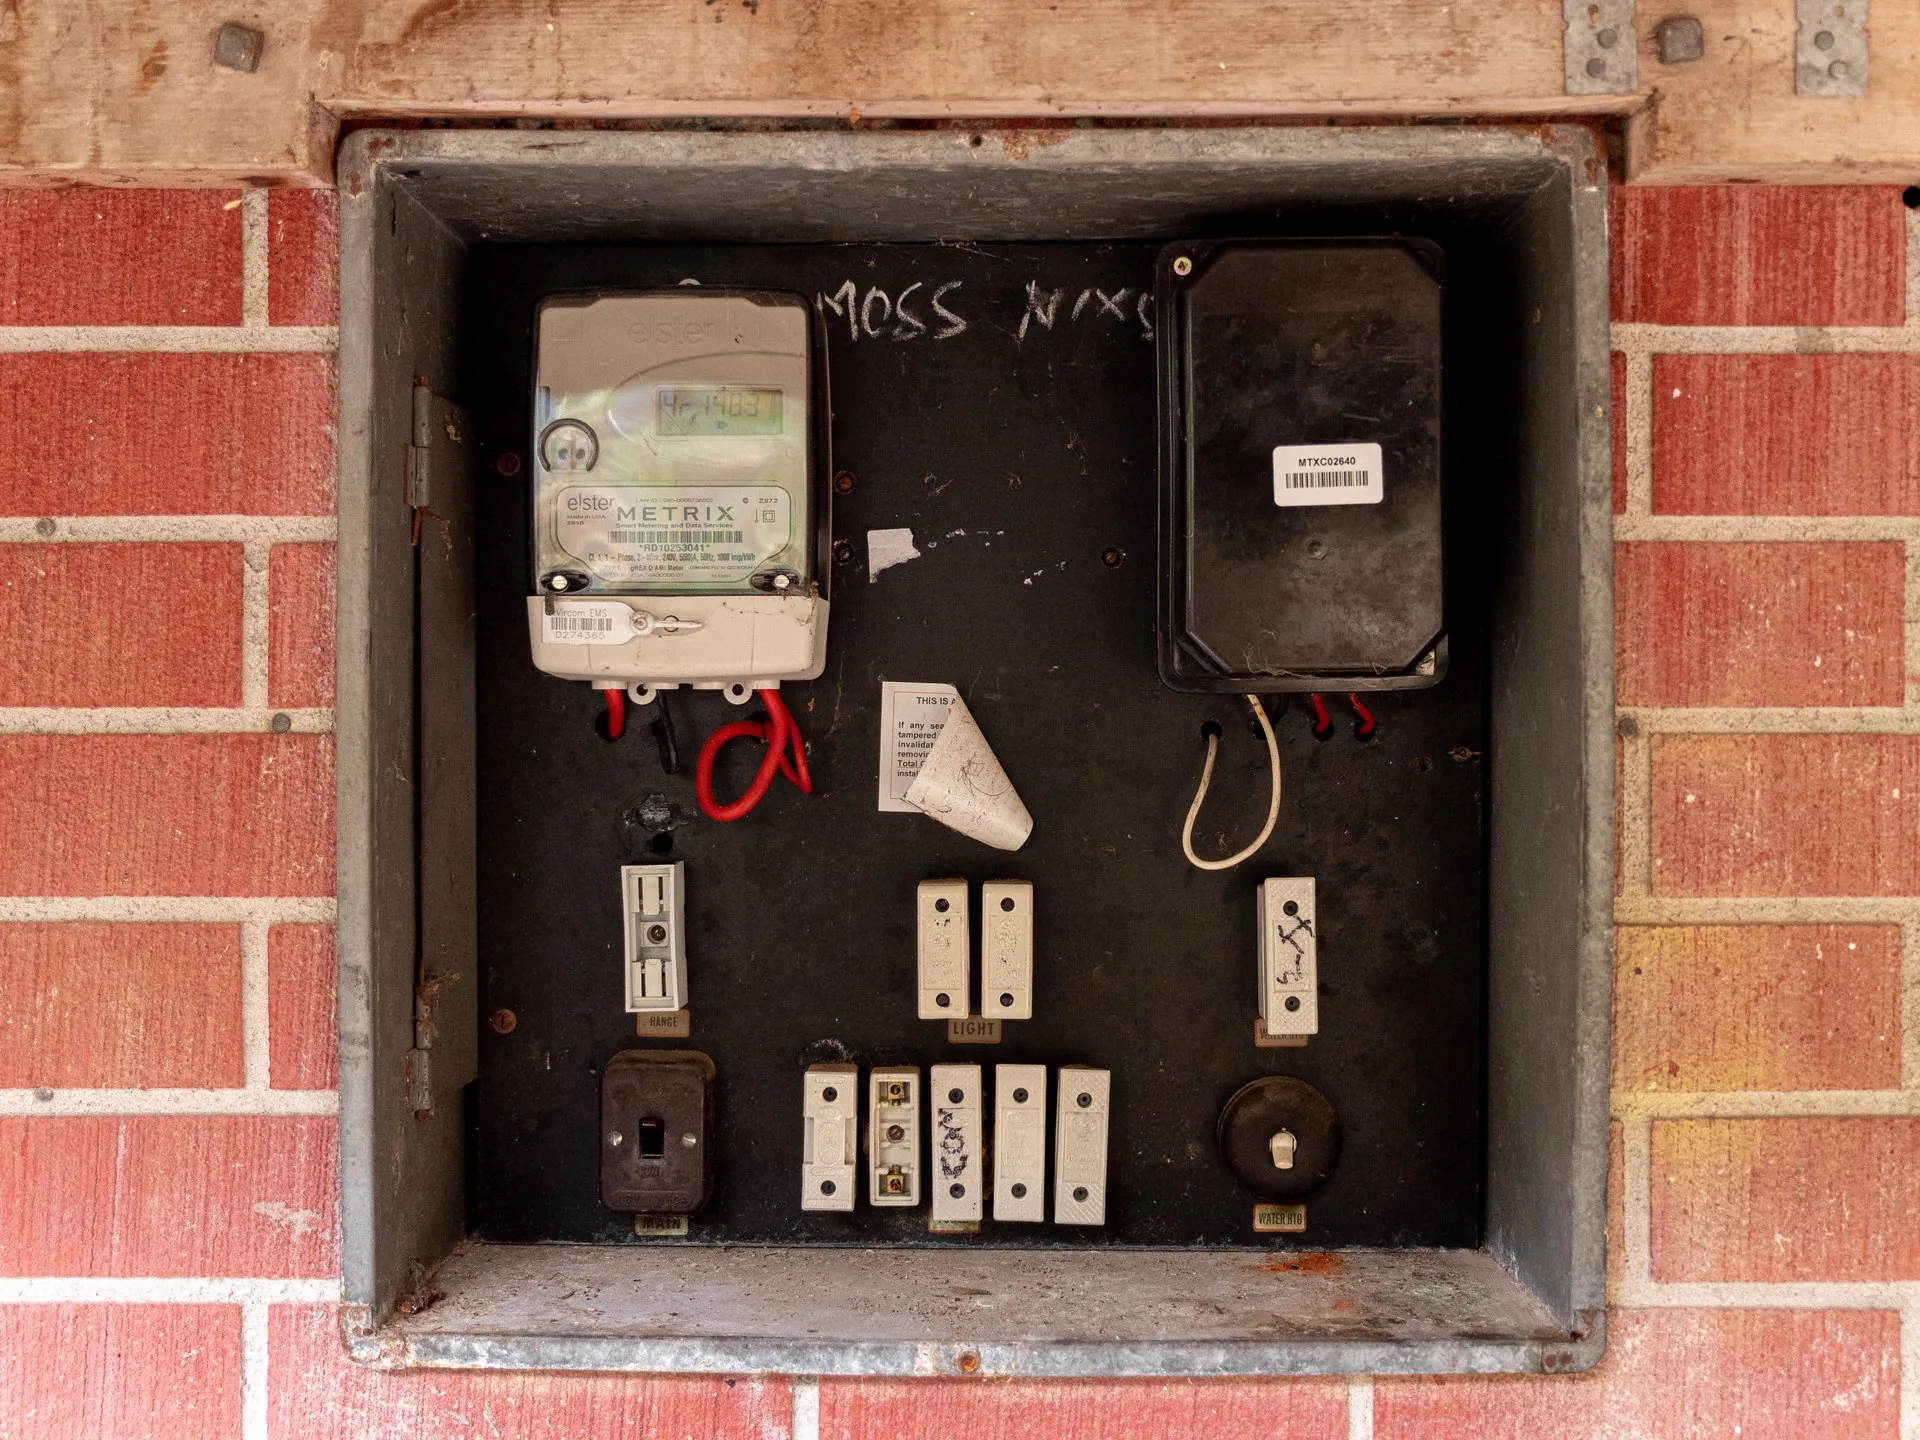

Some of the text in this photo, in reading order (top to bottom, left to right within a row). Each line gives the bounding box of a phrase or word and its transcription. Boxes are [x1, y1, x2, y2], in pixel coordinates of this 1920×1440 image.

[628, 314, 717, 344] elster
[1298, 457, 1356, 467] MTXC02640
[567, 493, 616, 511] elster
[617, 506, 735, 521] METRIX
[590, 608, 608, 618] EMS
[556, 631, 606, 639] 0274365
[917, 697, 937, 705] THIS
[939, 697, 948, 705] IS
[910, 723, 924, 731] any
[898, 732, 937, 740] tampered
[897, 760, 918, 768] Total
[650, 1016, 678, 1028] RANGE
[953, 1022, 995, 1035] LIGHT
[640, 1216, 682, 1229] MAIN
[1258, 1212, 1303, 1225] WATER HTG
